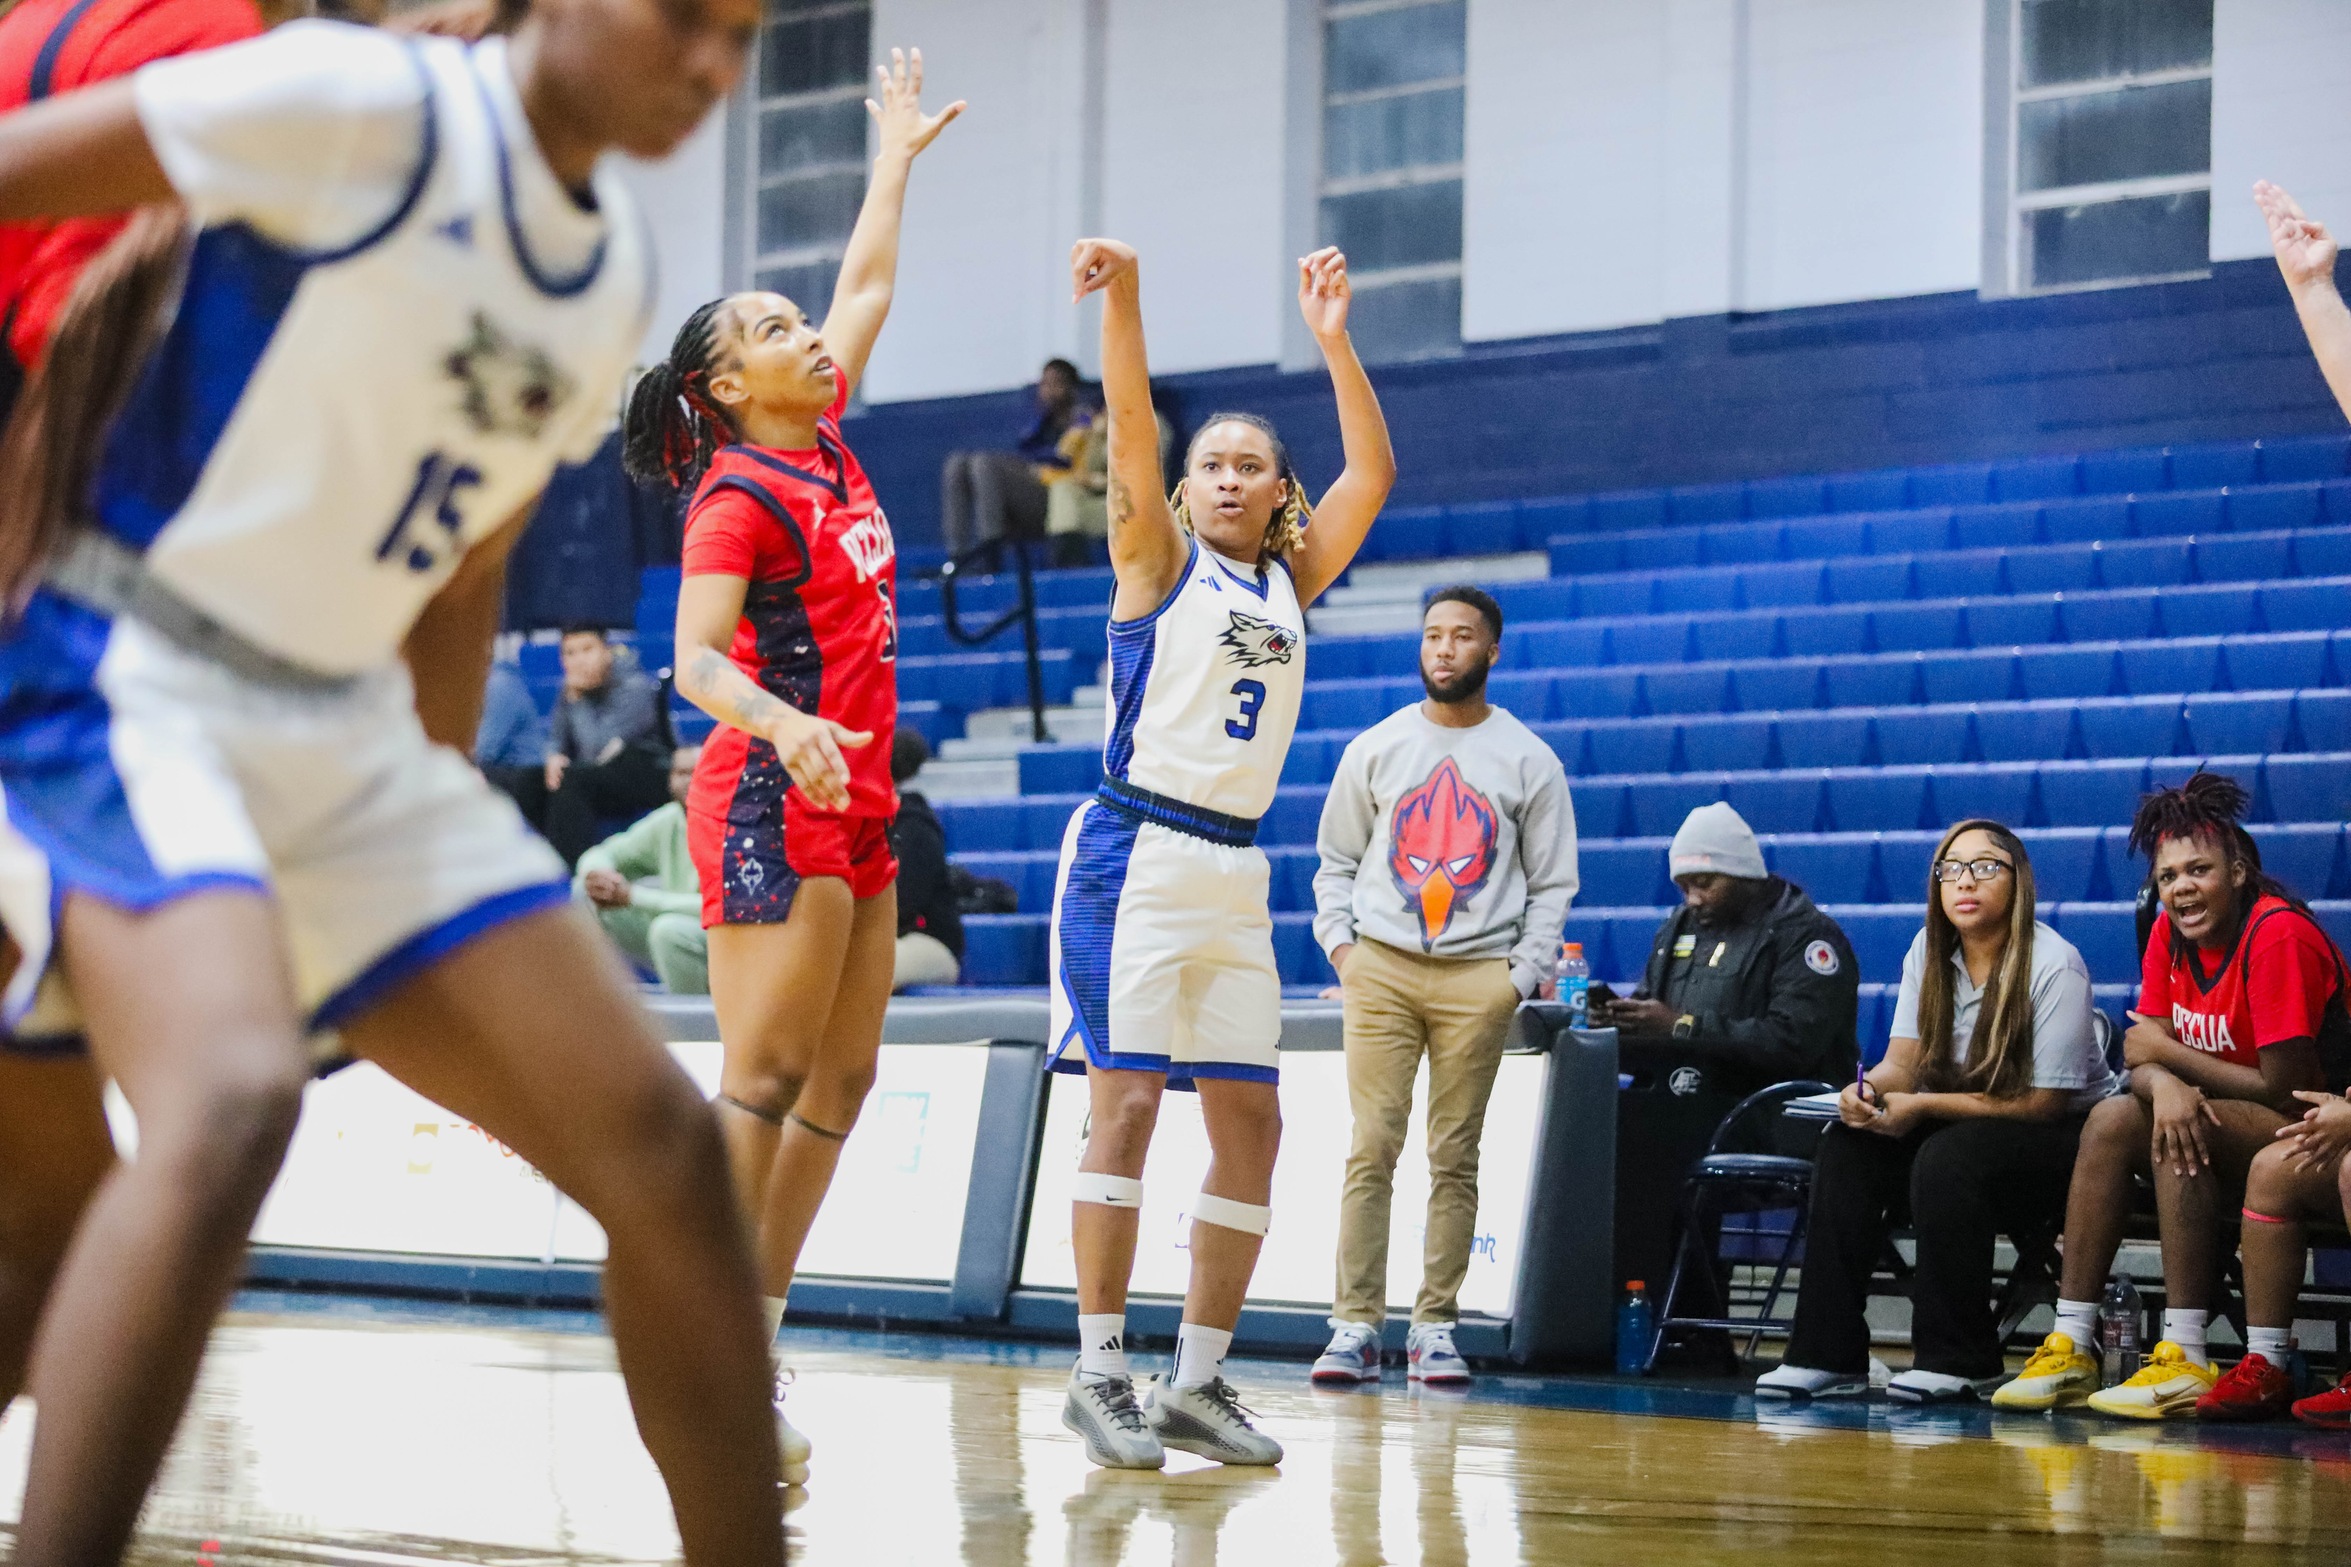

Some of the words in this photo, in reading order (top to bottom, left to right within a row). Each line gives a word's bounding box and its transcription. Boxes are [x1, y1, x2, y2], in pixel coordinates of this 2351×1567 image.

[375, 451, 483, 572] 15
[1224, 677, 1267, 742] 3
[2172, 1001, 2237, 1052] PCCUA
